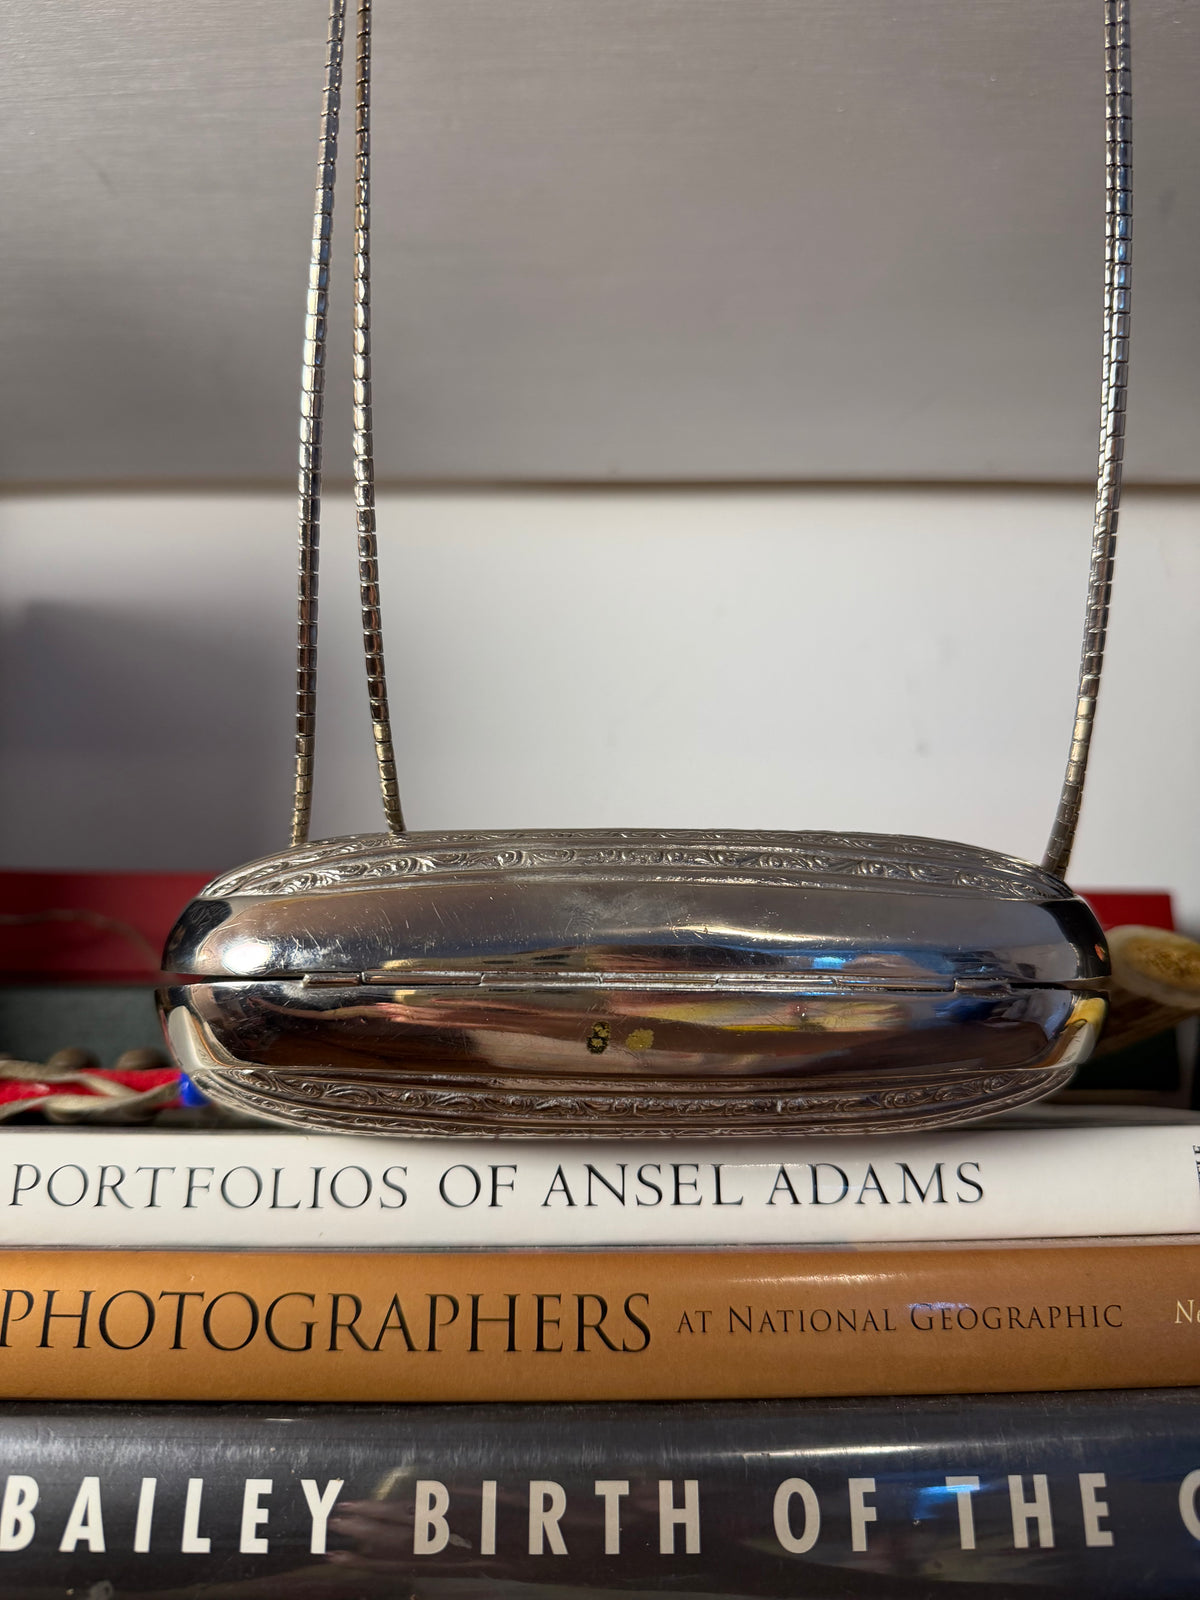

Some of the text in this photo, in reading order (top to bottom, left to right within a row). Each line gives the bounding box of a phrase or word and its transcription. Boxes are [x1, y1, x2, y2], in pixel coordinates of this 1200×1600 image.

[9, 1161, 985, 1210] PORTFOLIOS OF ANSEL ADAMS
[0, 1288, 1124, 1353] PHOTOGRAPHERS AT NATIONAL GEOGRAPHIC
[0, 1475, 345, 1555] BAILEY
[413, 1479, 701, 1556] BIRTH
[773, 1477, 878, 1554] OF
[946, 1472, 1115, 1551] THE
